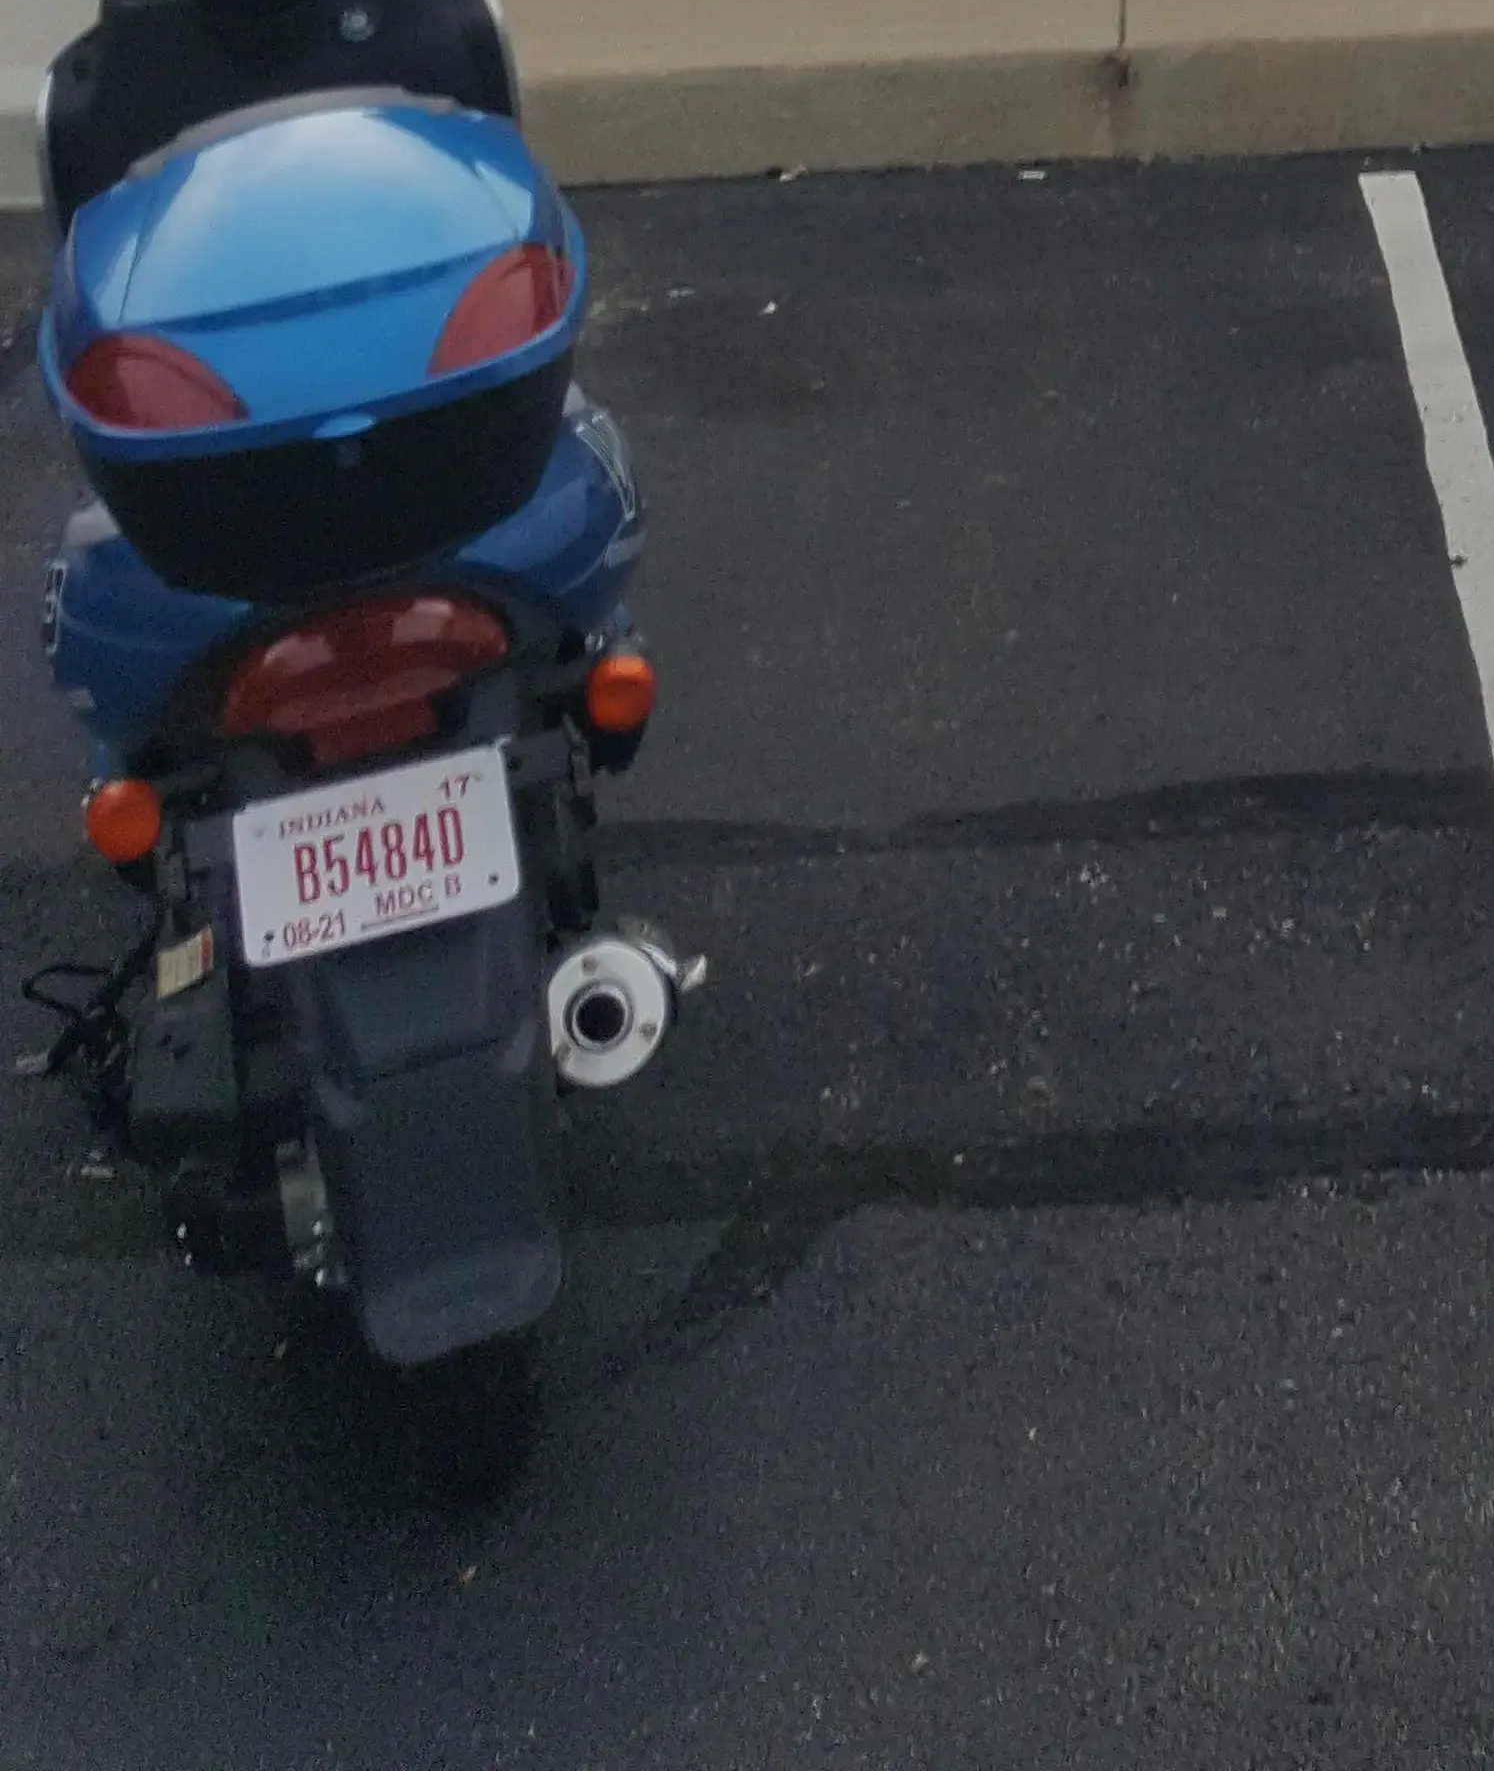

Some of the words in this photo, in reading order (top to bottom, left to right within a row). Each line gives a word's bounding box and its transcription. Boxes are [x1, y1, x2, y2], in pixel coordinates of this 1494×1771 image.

[438, 773, 470, 799] 17
[278, 796, 386, 839] INDIANA
[294, 806, 465, 905] B5484D
[373, 880, 434, 916] MDC
[282, 909, 346, 949] 08-21
